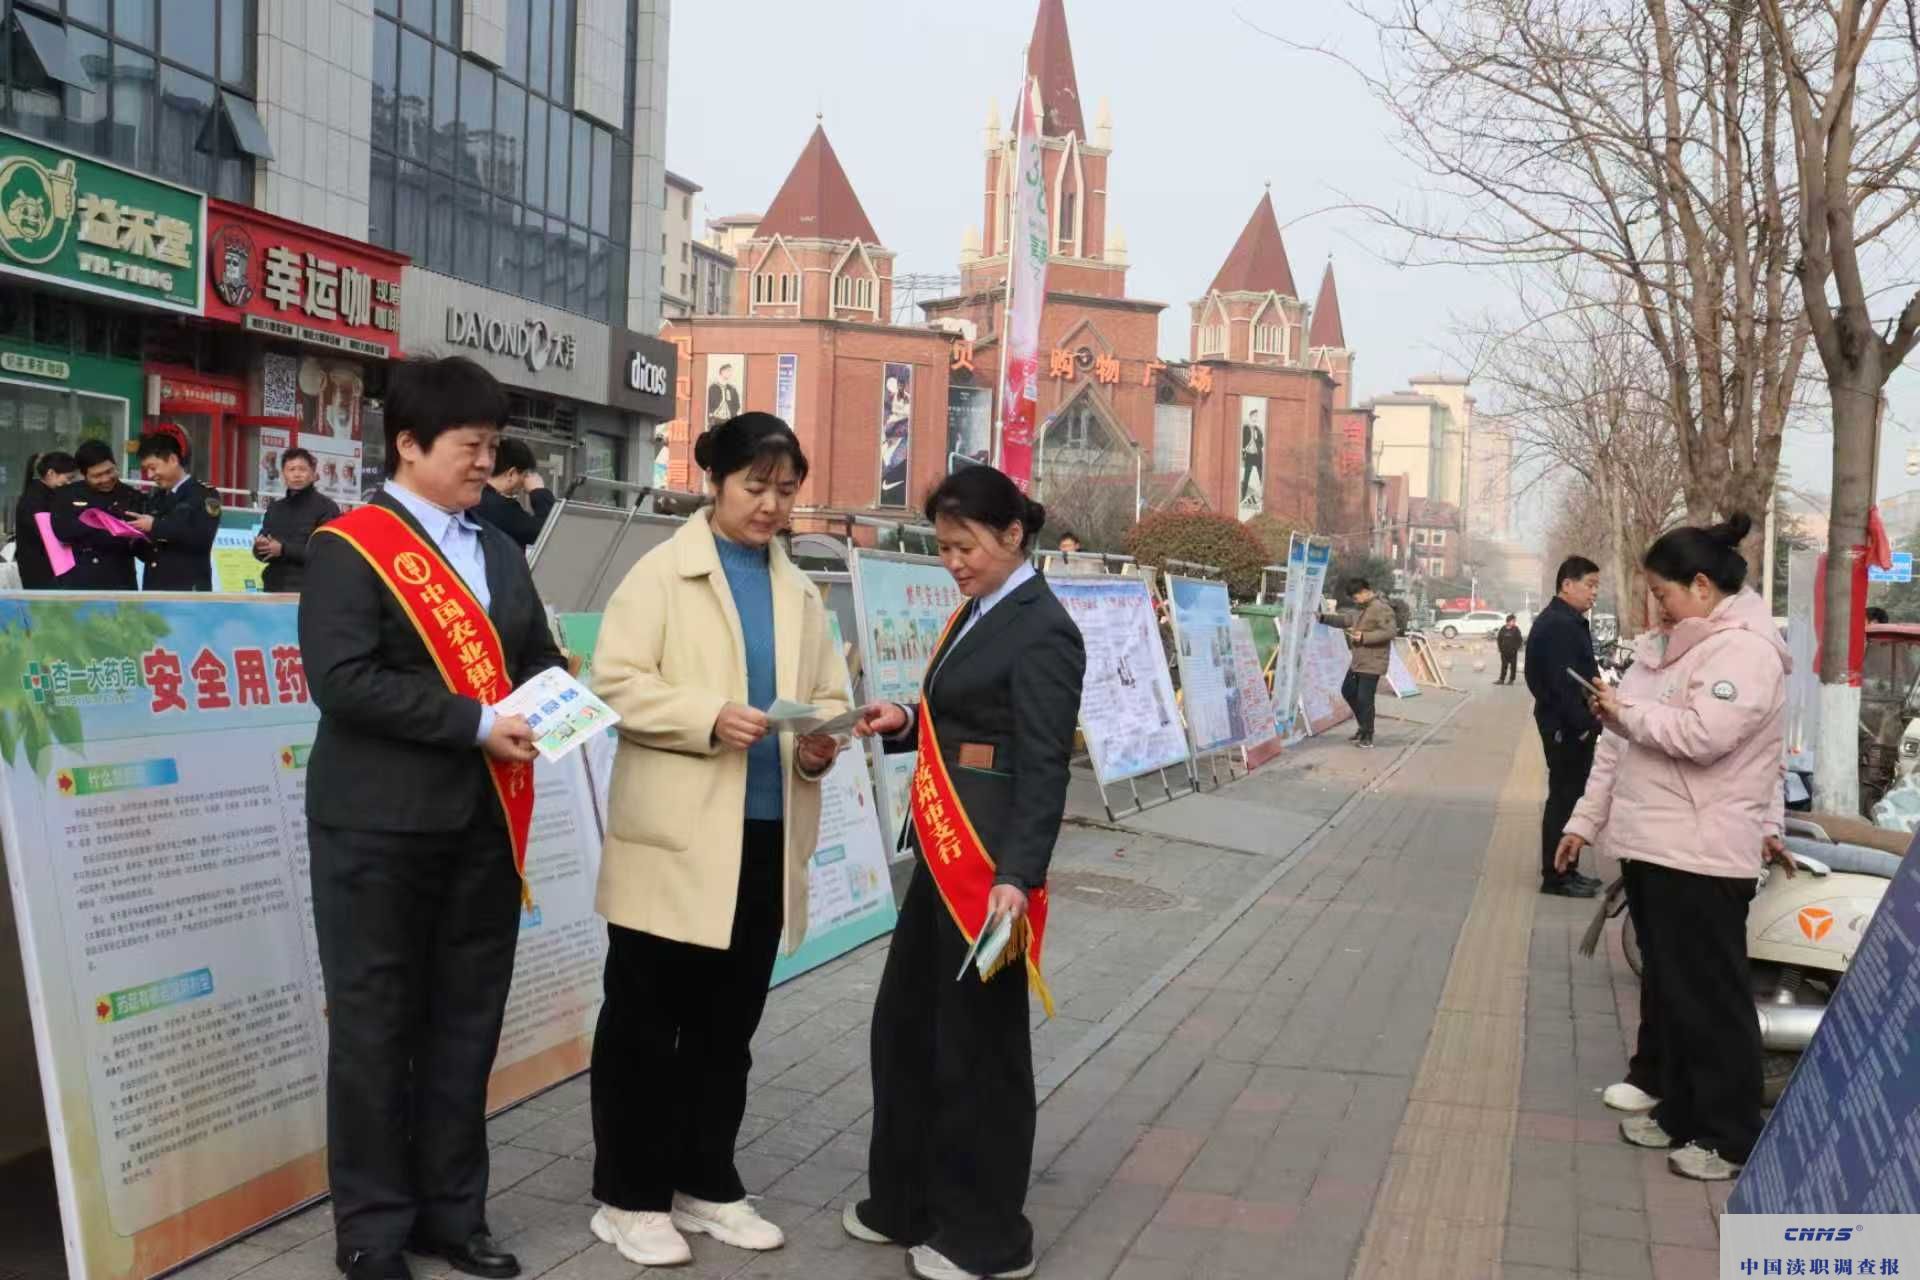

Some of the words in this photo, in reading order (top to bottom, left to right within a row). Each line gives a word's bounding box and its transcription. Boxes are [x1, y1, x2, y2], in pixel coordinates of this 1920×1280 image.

[77, 193, 193, 268] 益禾堂
[265, 246, 371, 326] 幸运咖
[631, 351, 667, 395] dicos
[51, 659, 137, 690] 杏一大药房
[143, 645, 309, 713] 安全用药
[420, 583, 498, 705] 中国农业银行
